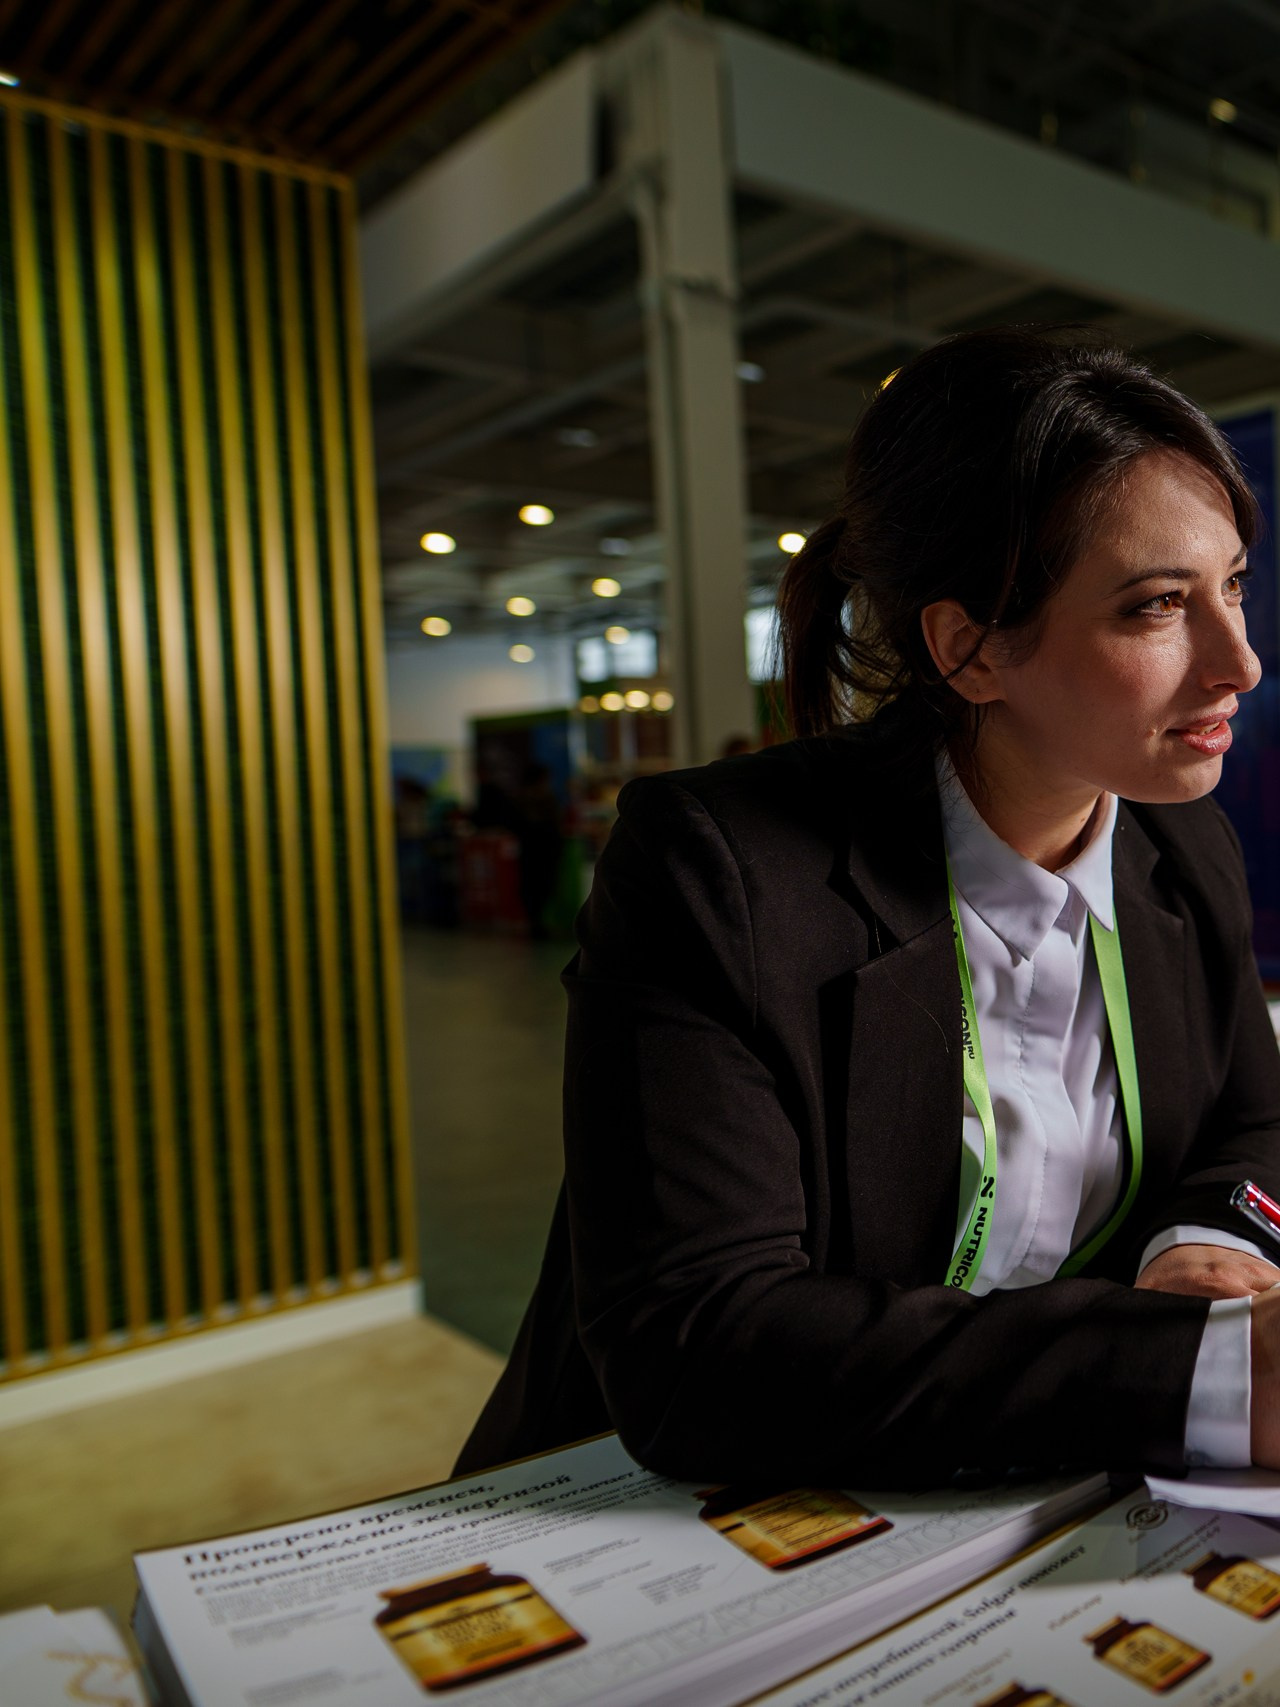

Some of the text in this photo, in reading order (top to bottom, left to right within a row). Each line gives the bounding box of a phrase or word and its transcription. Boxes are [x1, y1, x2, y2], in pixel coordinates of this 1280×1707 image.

[950, 1206, 988, 1288] NUTRICO
[183, 1521, 353, 1565] Проверено
[358, 1484, 496, 1525] временем,
[190, 1523, 405, 1580] подтверждено
[410, 1474, 573, 1528] экспертизой
[1018, 1544, 1086, 1590] поможет
